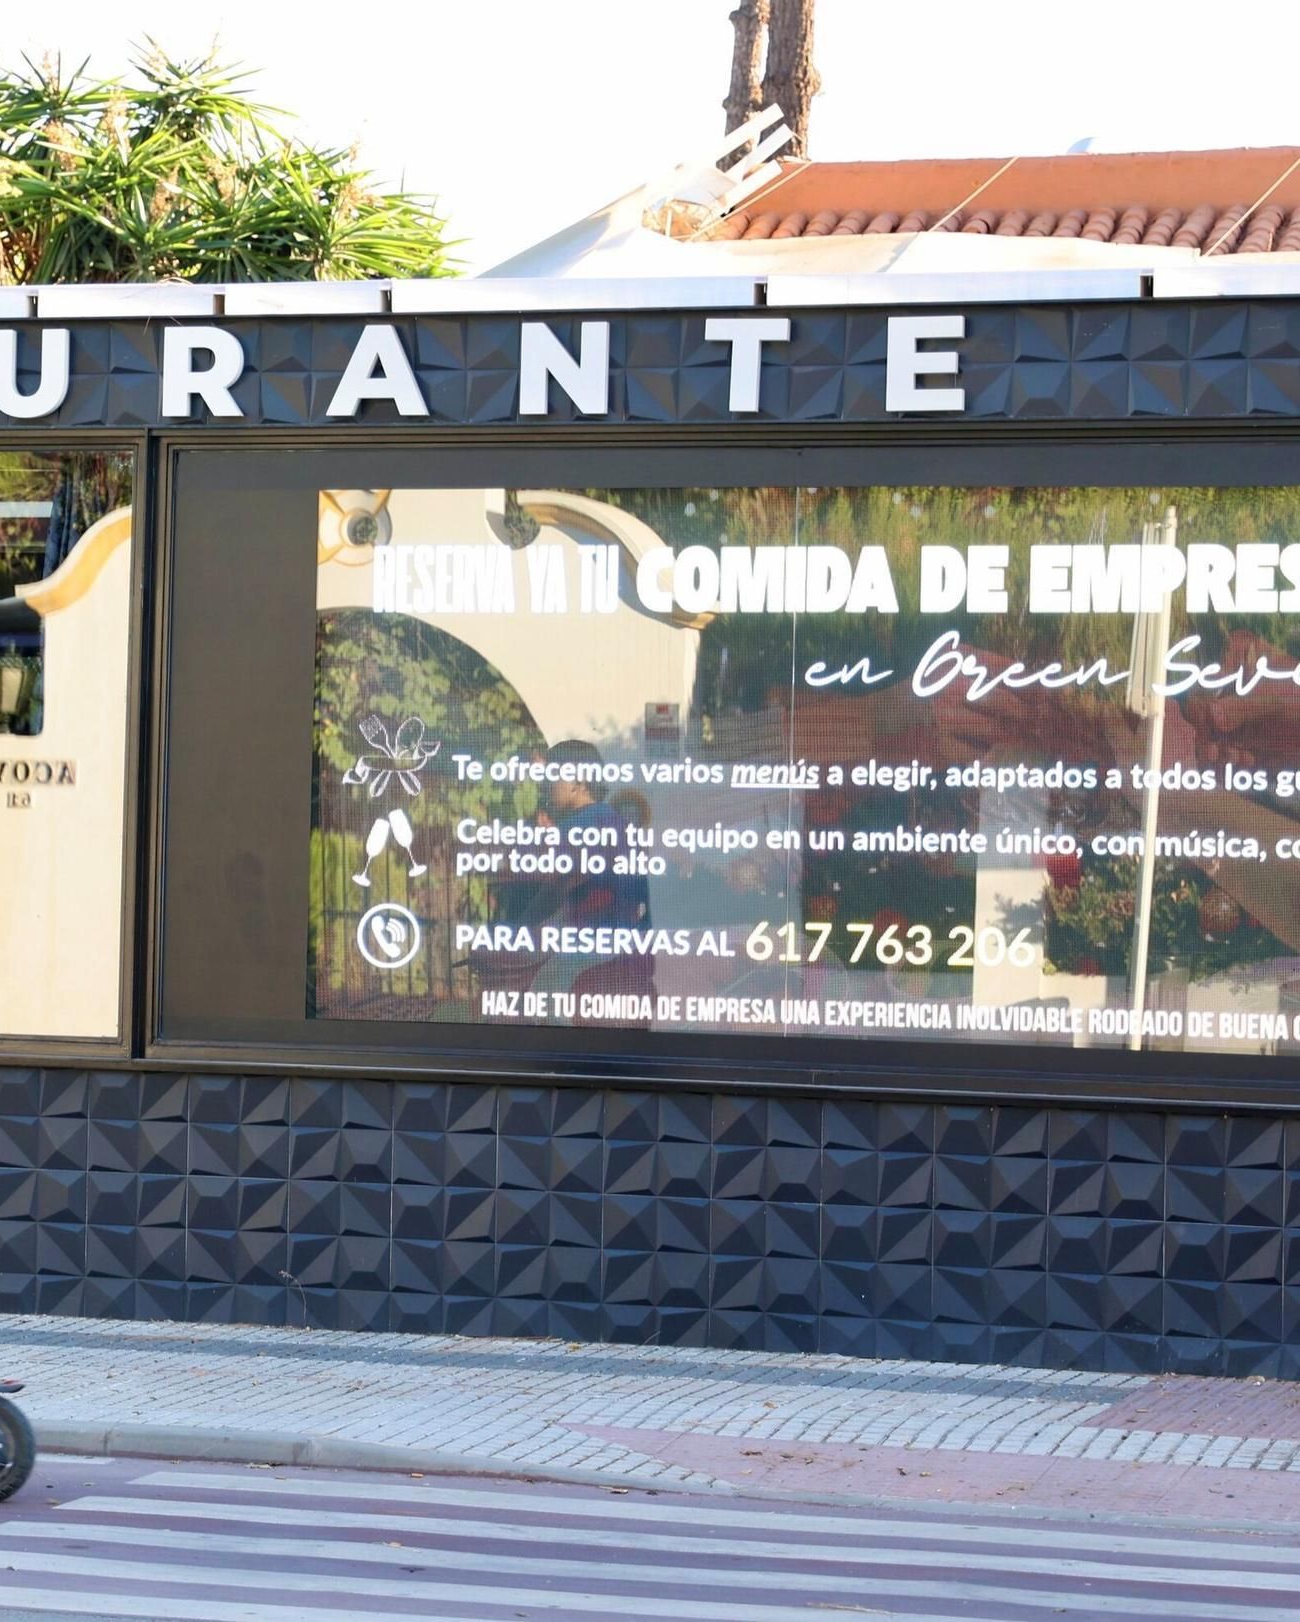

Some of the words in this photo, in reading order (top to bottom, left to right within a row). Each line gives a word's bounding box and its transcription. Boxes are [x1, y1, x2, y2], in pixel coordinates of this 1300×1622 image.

[372, 544, 515, 613] RESERVA
[526, 544, 568, 613] YA
[577, 544, 620, 613] TU
[636, 545, 899, 613] COMIDA
[920, 545, 1009, 613] DE
[804, 657, 893, 687] en
[912, 630, 1132, 701] Green
[452, 754, 482, 781] Te
[489, 756, 634, 783] ofrecemos
[640, 758, 724, 784] varios
[731, 759, 820, 788] menús
[827, 766, 843, 786] a
[851, 760, 937, 791] elegir,
[945, 761, 1097, 792] adaptados
[1104, 769, 1122, 790] a
[1130, 762, 1217, 791] todos
[1224, 763, 1268, 791] los
[456, 853, 502, 877] por
[508, 849, 573, 874] todo
[581, 849, 606, 874] lo
[613, 851, 666, 875] alto
[457, 818, 560, 847] Celebra
[568, 827, 617, 847] con
[625, 823, 656, 848] tu
[662, 823, 758, 854] equipo
[766, 829, 800, 850] en
[808, 831, 844, 852] un
[852, 826, 987, 854] ambiente
[996, 828, 1082, 858] único,
[1091, 834, 1144, 856] con
[1155, 830, 1266, 862] música,
[456, 925, 535, 953] PARA
[541, 928, 691, 956] RESERVAS
[696, 931, 735, 957] AL
[746, 921, 832, 962] 617
[847, 923, 932, 965] 763
[947, 926, 1036, 967] 206
[482, 991, 519, 1016] HAZ
[523, 992, 547, 1017] DE
[552, 992, 576, 1018] TU
[580, 993, 652, 1020] COMIDA
[657, 996, 680, 1021] DE
[686, 997, 776, 1024] EMPRESA
[781, 999, 820, 1026] UNA
[825, 1001, 951, 1031] EXPERIENCIA
[957, 1004, 1082, 1034] INOLVIDABLE
[1089, 1008, 1182, 1037] RODEADO
[1188, 1011, 1214, 1038] DE
[1219, 1012, 1289, 1040] BUENA
